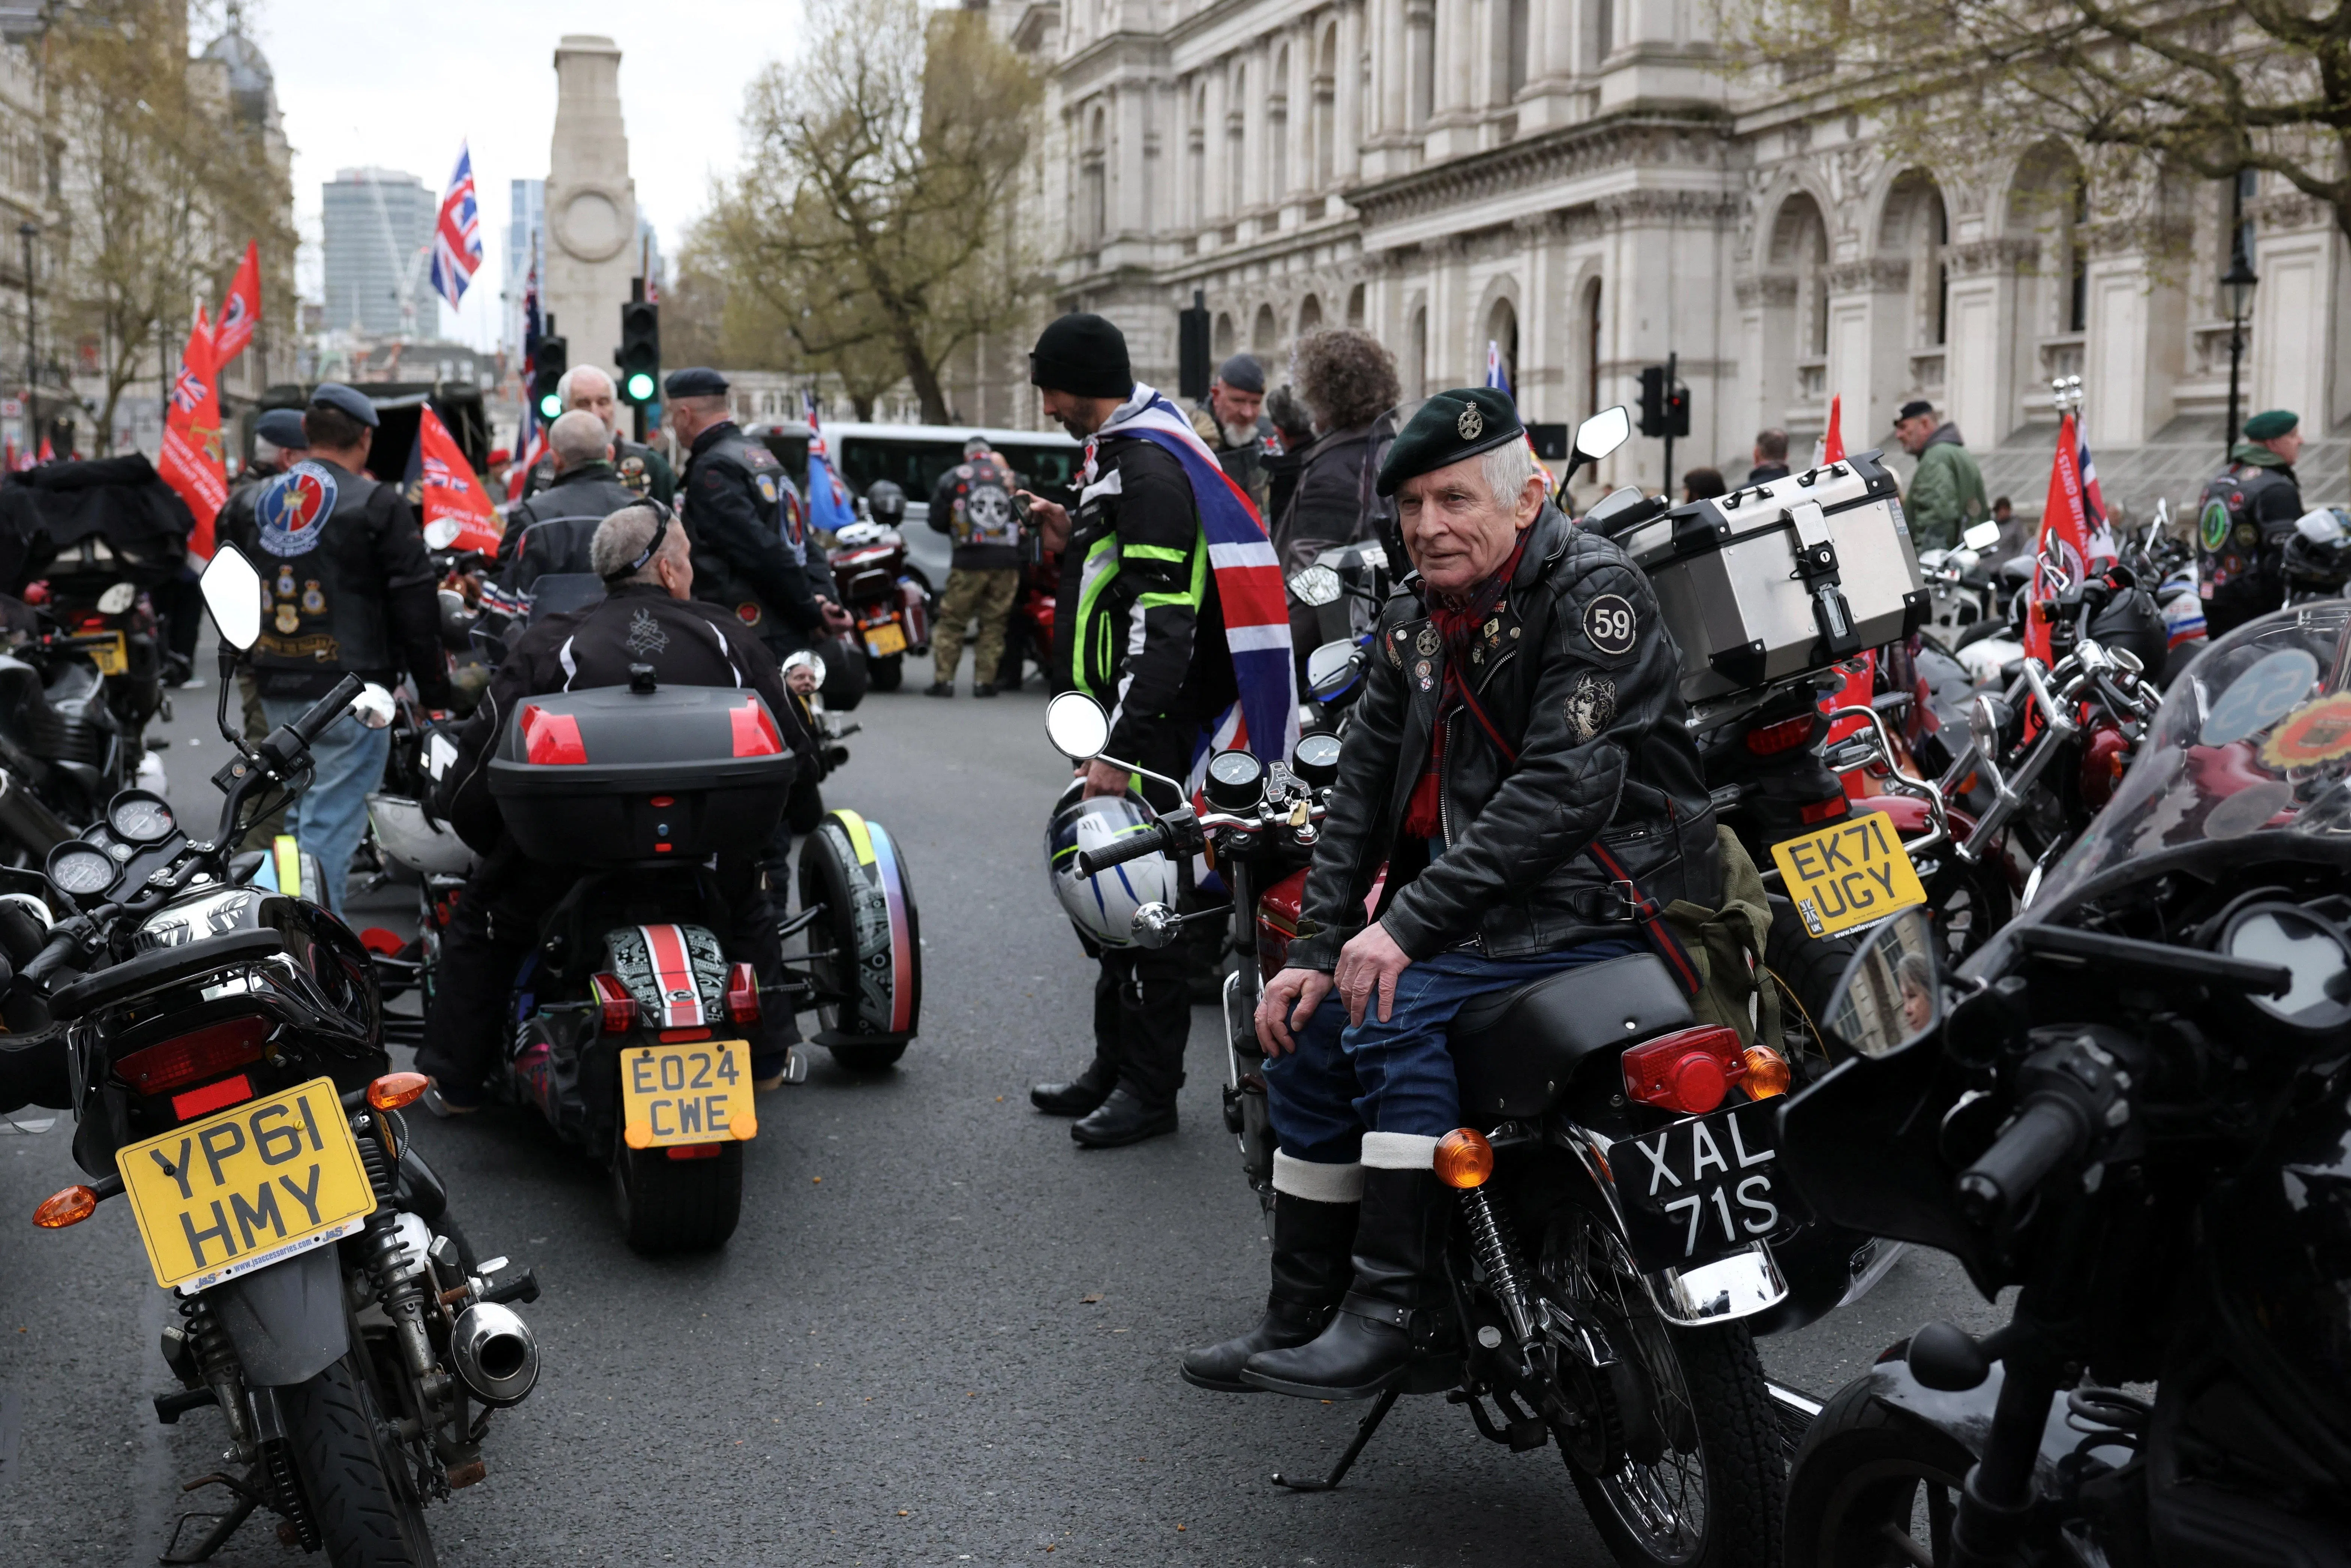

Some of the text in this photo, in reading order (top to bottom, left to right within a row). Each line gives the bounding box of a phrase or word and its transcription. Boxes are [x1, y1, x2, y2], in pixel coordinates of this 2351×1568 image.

[2058, 455, 2078, 496] STAND
[2068, 495, 2086, 530] WITH
[1594, 609, 1630, 640] 59
[1788, 820, 1890, 881] EK71
[1812, 862, 1895, 918] UGY
[1811, 923, 1822, 932] UK
[650, 1095, 731, 1136] CWE
[149, 1096, 324, 1200] YP61
[1636, 1113, 1776, 1196] XAL
[179, 1163, 321, 1269] HMY
[1665, 1175, 1779, 1257] 71S
[195, 1226, 344, 1289] J&S www.jsaccessories.com J&S
